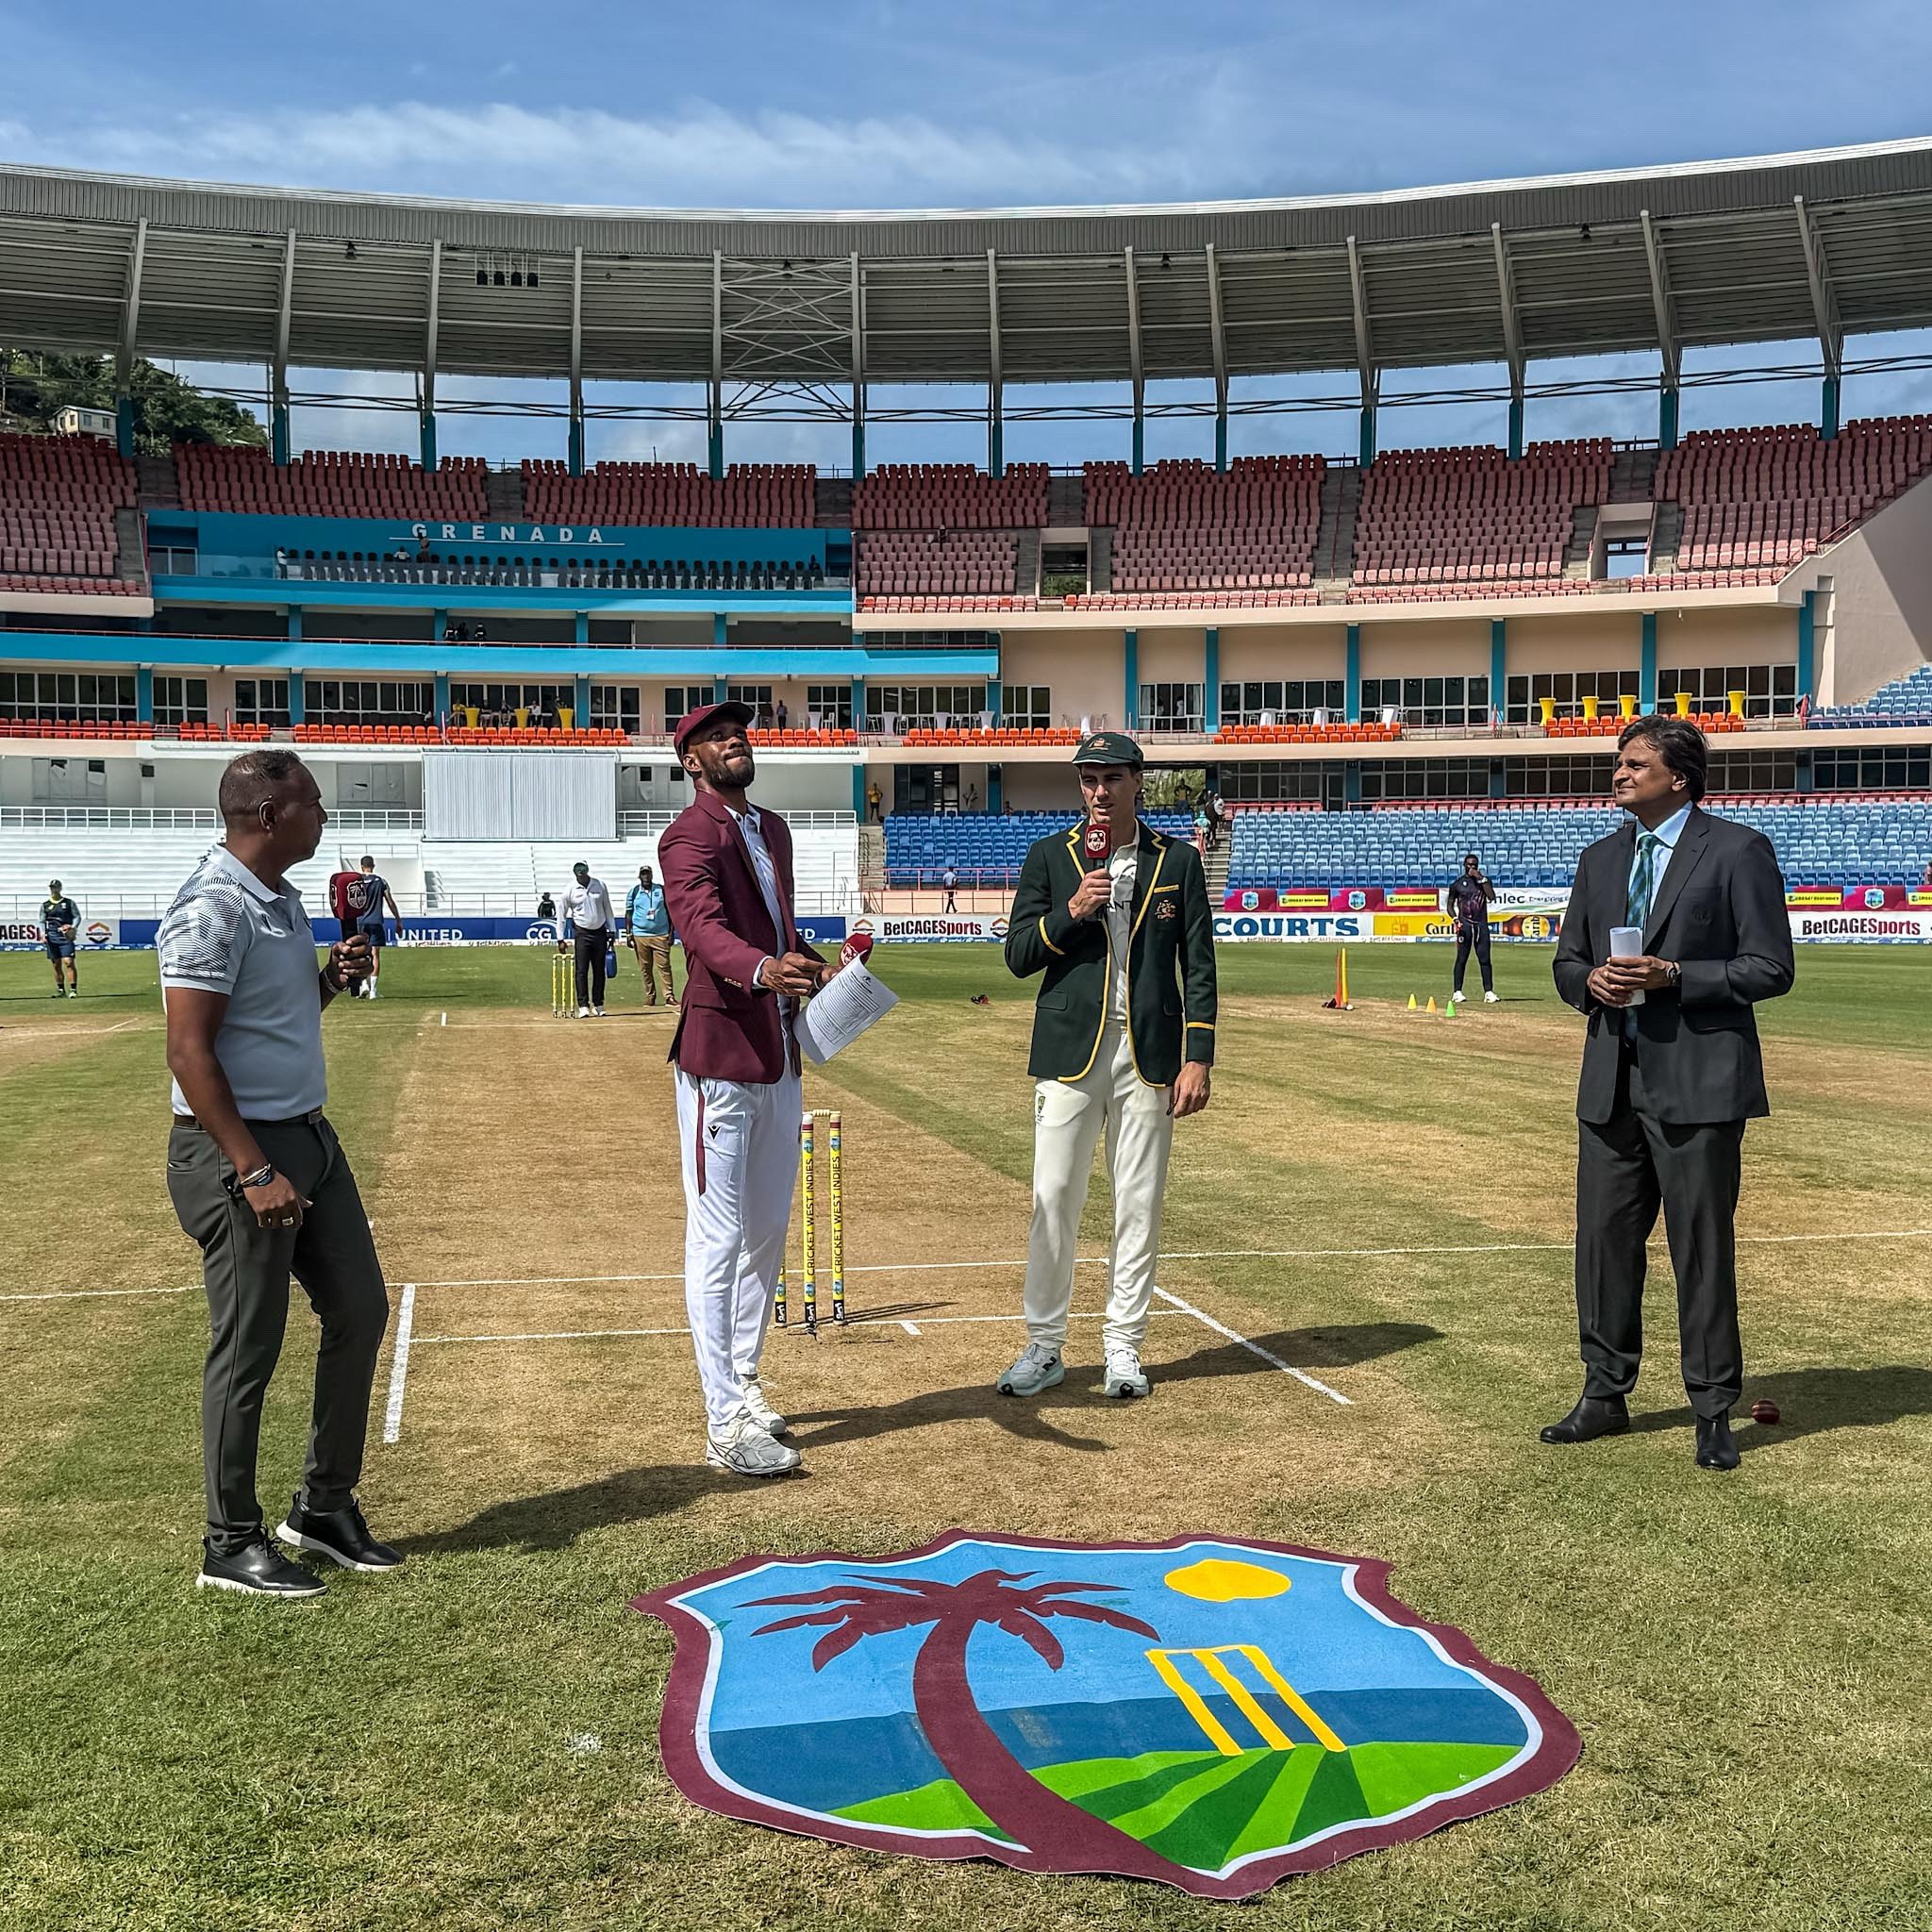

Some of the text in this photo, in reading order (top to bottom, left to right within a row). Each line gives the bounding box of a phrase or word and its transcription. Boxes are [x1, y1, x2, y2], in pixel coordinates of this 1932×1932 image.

[411, 523, 604, 543] GRENADA
[395, 928, 463, 941] UNITED
[525, 927, 552, 941] CG
[883, 920, 982, 936] BetCAGESports
[1212, 917, 1359, 937] COURTS
[1530, 916, 1541, 938] arib
[1802, 918, 1921, 936] BetCAGESports
[806, 1158, 815, 1276] CRICKET WEST INDIES
[832, 1156, 843, 1274] CRICKET WEST INDIES
